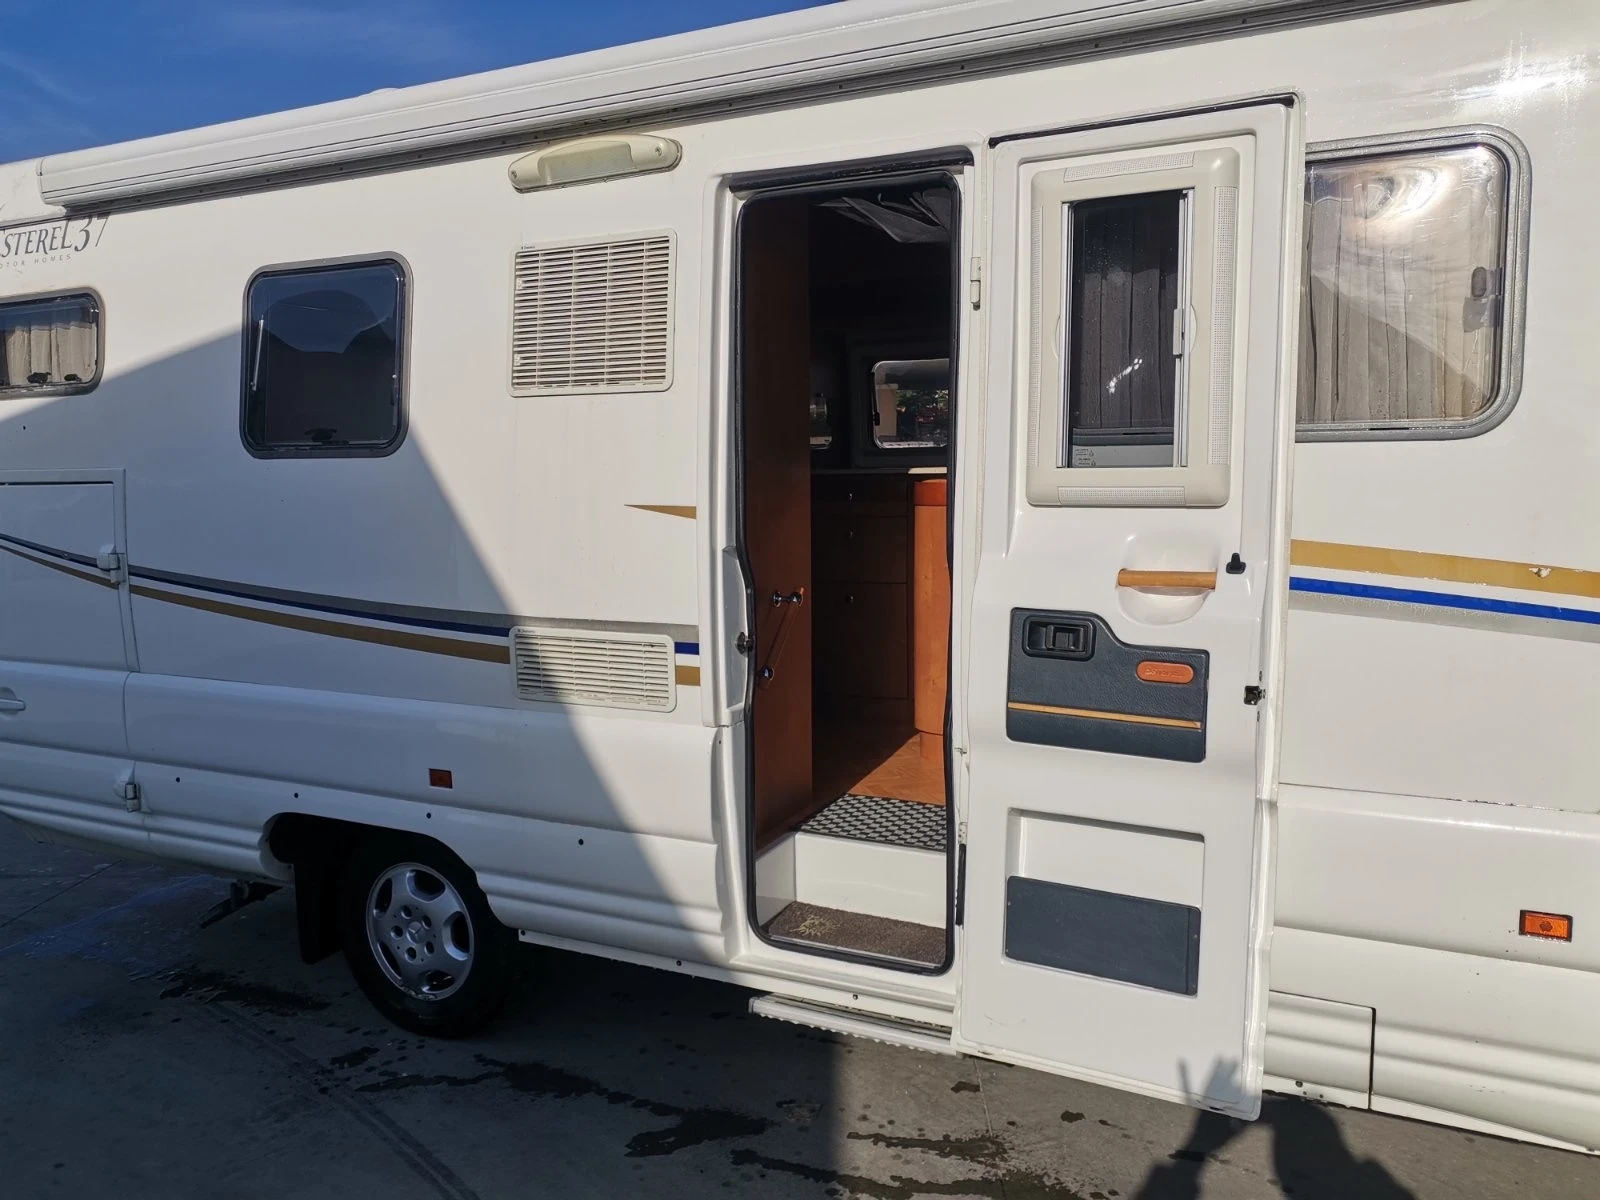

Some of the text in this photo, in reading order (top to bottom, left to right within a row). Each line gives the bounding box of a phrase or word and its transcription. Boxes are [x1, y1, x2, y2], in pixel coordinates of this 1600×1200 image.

[0, 213, 110, 258] STEREL 37
[34, 254, 72, 264] HOMES
